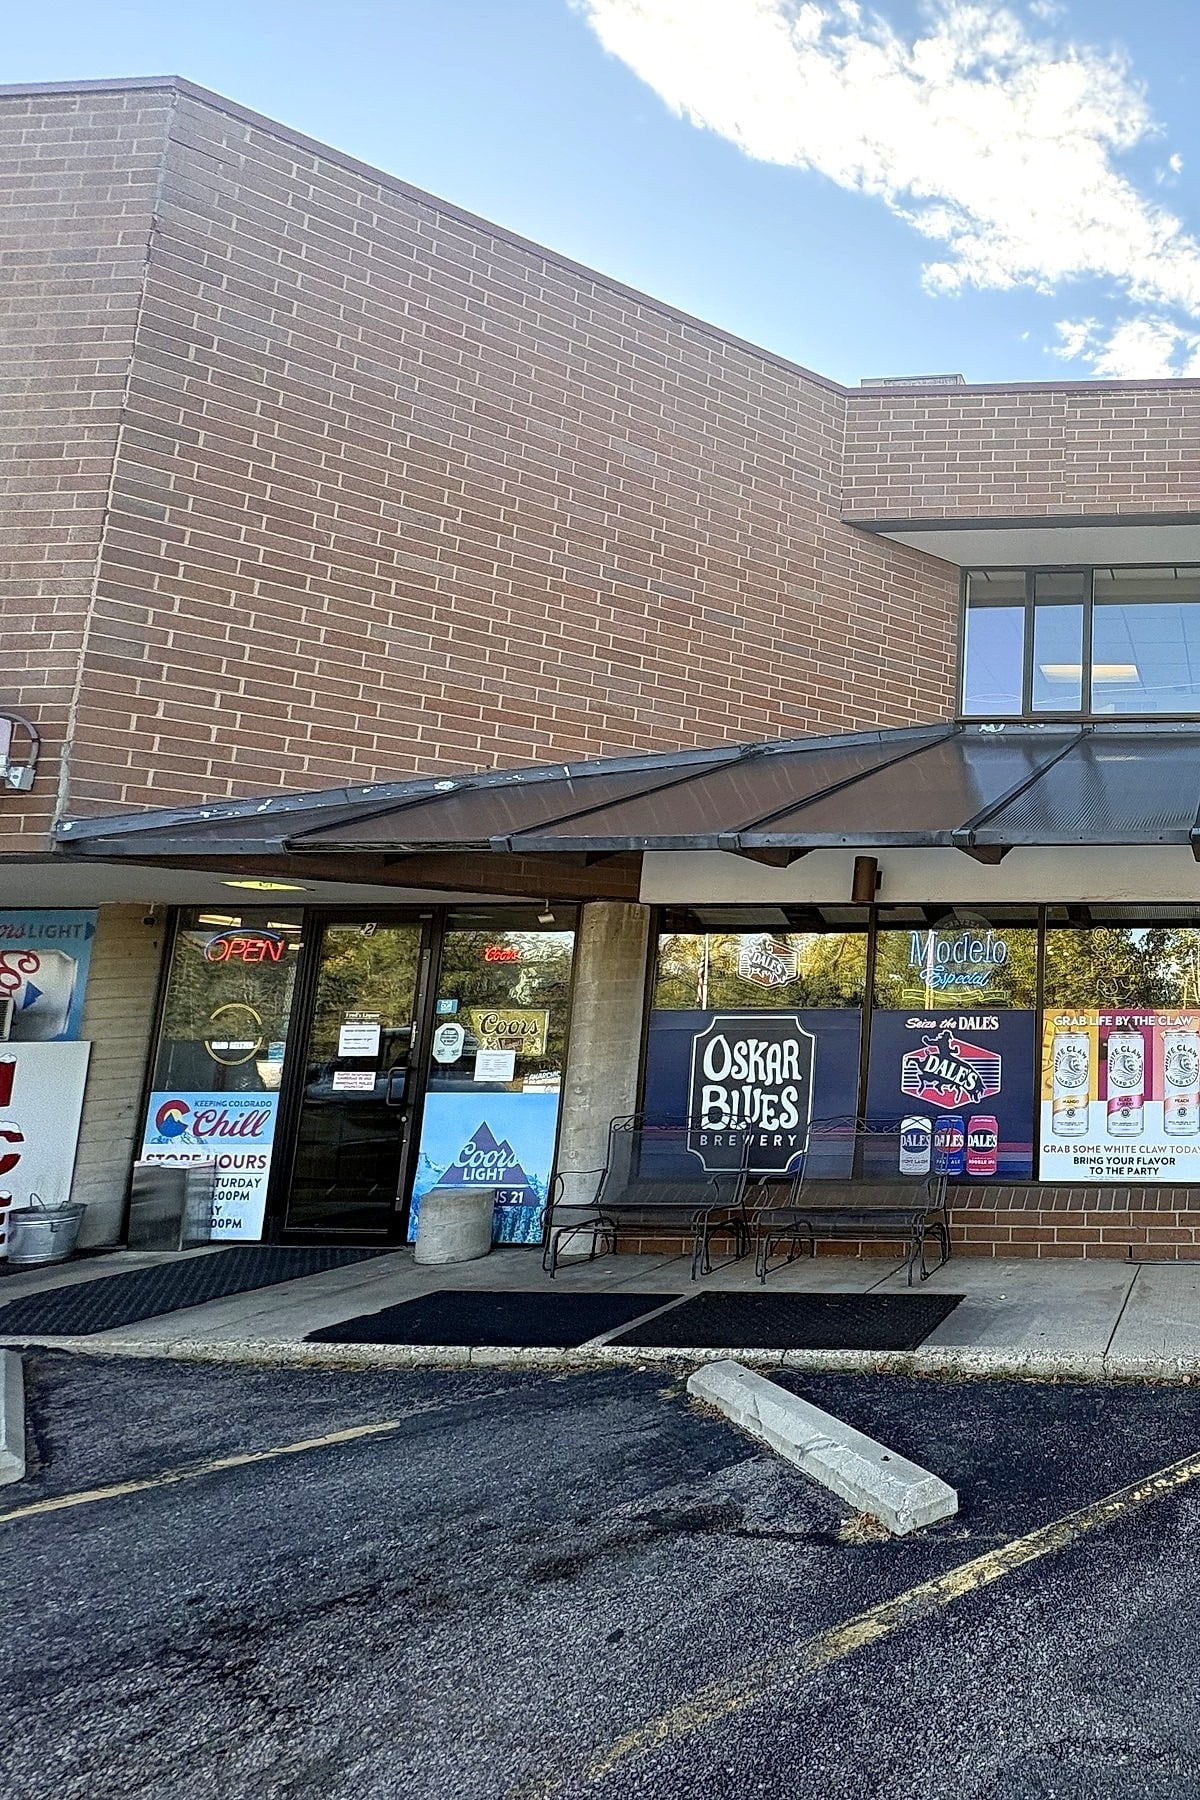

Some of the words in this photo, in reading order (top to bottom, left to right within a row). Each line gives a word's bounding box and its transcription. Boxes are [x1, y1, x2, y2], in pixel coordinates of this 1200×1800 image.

[28, 924, 83, 938] LIGHT
[364, 923, 374, 935] 2
[208, 939, 285, 961] OPEN
[485, 945, 517, 961] Coors
[908, 930, 1006, 966] Modelo
[920, 965, 991, 989] Especial
[479, 1013, 539, 1035] Coors
[905, 1018, 937, 1029] Seize
[939, 1017, 957, 1029] the
[1054, 1015, 1087, 1026] GRAB
[1089, 1015, 1113, 1026] LIFE
[1115, 1015, 1129, 1026] BY
[1131, 1015, 1156, 1026] THE
[1158, 1015, 1193, 1026] CLAW
[703, 1034, 802, 1086] OSKAR
[1054, 1048, 1066, 1072] WHITE
[1066, 1045, 1088, 1060] CLAW
[1109, 1048, 1120, 1072] WHITE
[1120, 1045, 1142, 1060] CLAW
[1165, 1047, 1175, 1072] WHITE
[1176, 1044, 1199, 1059] CLAW
[701, 1085, 799, 1131] BLUES
[192, 1109, 272, 1137] Chill
[700, 1134, 797, 1147] BREWERY
[453, 1141, 519, 1168] Coors
[1043, 1145, 1070, 1154] GRAB
[1073, 1145, 1101, 1154] SOME
[1103, 1145, 1137, 1154] WHITE
[1138, 1145, 1167, 1154] CLAW
[206, 1154, 268, 1169] HOURS
[1073, 1156, 1104, 1165] BRING
[1106, 1157, 1135, 1165] YOUR
[1136, 1157, 1176, 1166] FLAVOR
[463, 1167, 507, 1181] LIGHT
[1089, 1166, 1104, 1175] TO
[1106, 1167, 1125, 1175] THE
[1127, 1167, 1159, 1176] PARTY
[215, 1178, 261, 1188] TURDAY
[509, 1191, 524, 1204] 21
